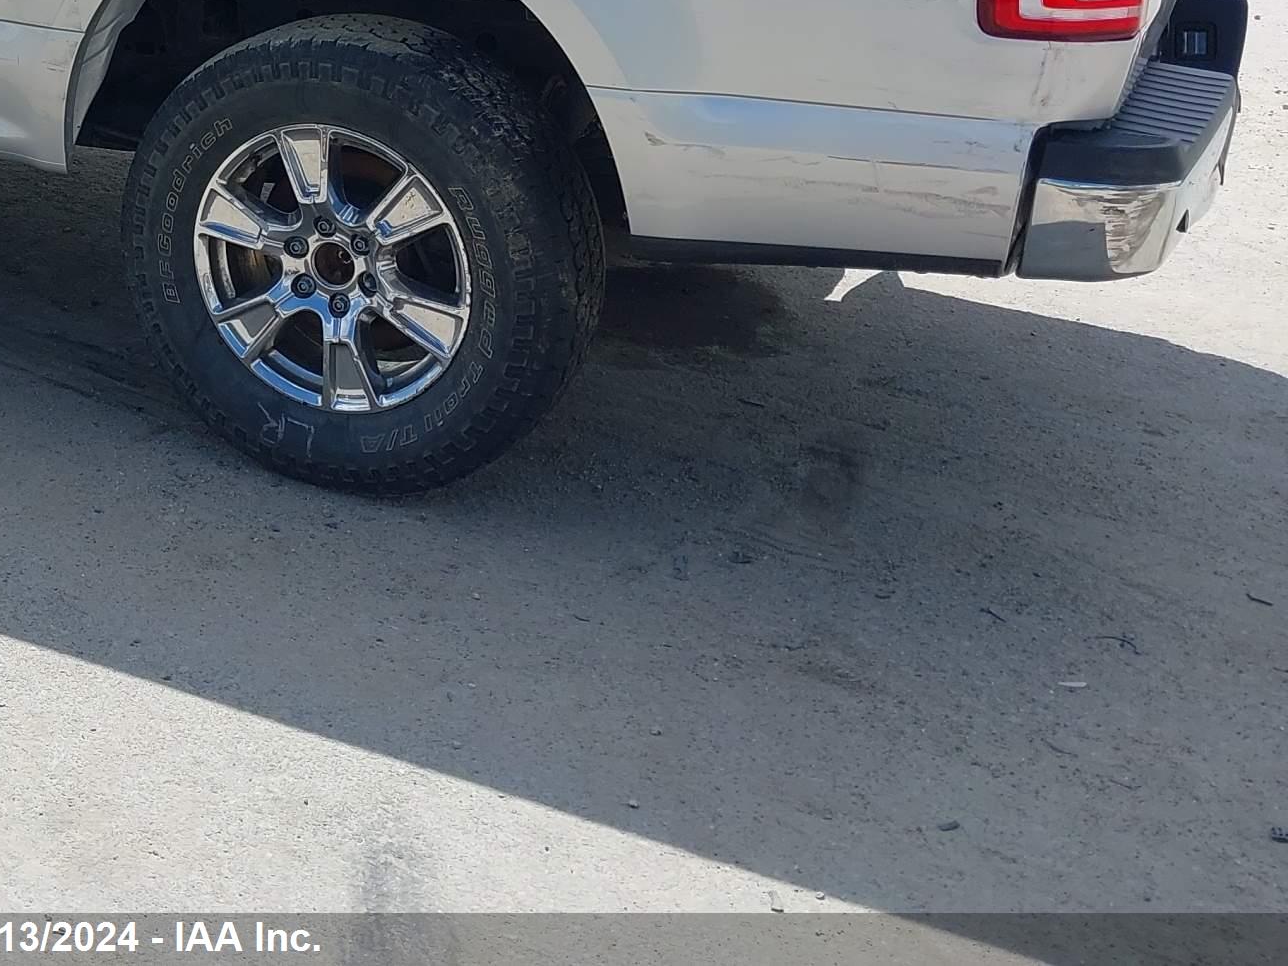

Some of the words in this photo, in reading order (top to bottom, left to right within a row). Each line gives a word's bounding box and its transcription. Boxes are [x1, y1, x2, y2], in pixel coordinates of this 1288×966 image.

[158, 117, 233, 304] BFGoodrich
[448, 187, 497, 359] Rugged
[361, 425, 418, 455] T/A
[423, 361, 484, 433] Trail
